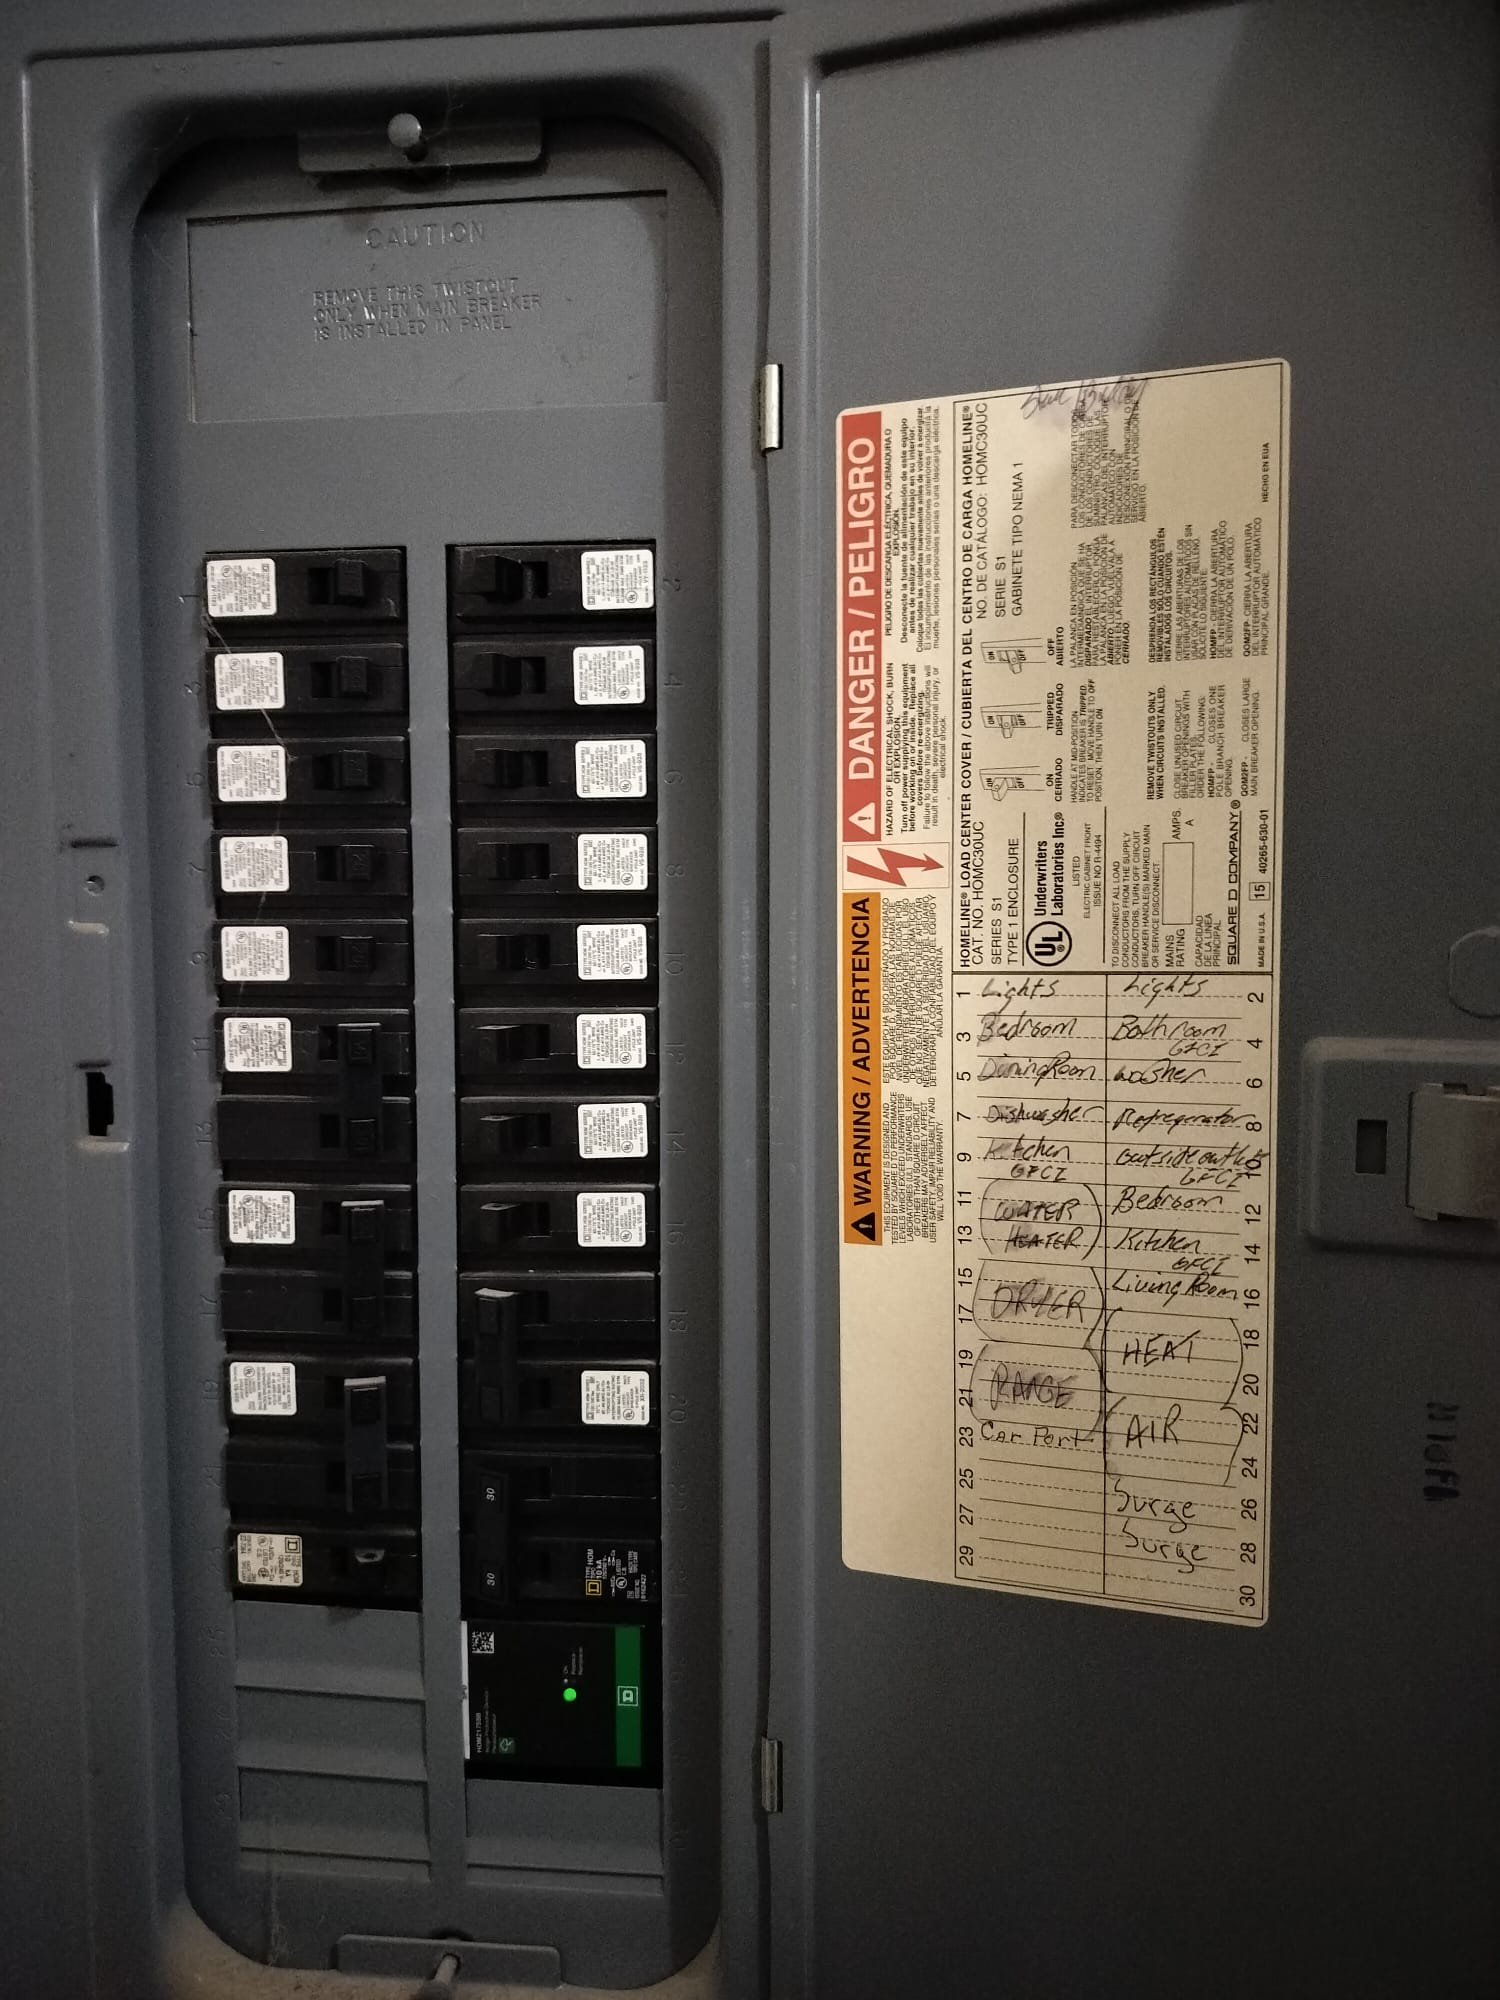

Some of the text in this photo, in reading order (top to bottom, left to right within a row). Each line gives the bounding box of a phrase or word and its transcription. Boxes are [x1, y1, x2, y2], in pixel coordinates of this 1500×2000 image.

[366, 221, 486, 249] CAUTION
[313, 278, 518, 306] REMOVE THIS TWISTOUT
[313, 295, 542, 323] ONLY WHEN MAIN BREAKER
[314, 314, 511, 342] IS INSTALLED IN PANEL
[976, 403, 988, 485] HOMC30UC
[1262, 461, 1269, 472] EN
[1013, 472, 1023, 510] NEMA
[962, 490, 973, 538] CARGA
[1013, 515, 1023, 545] TIPO
[962, 543, 973, 562] DE
[962, 568, 973, 624] CENTRO
[977, 574, 987, 592] DE
[996, 556, 1006, 617] SERIE S1
[1013, 550, 1023, 616] GABINETE
[848, 437, 876, 780] DANGER PELIGRO
[977, 596, 987, 619] NO.
[962, 628, 973, 654] DEL
[1047, 638, 1055, 656] OFF
[1056, 626, 1064, 666] ABIERTO
[886, 690, 894, 724] SHOCK,
[962, 660, 972, 729] CUBIERTA
[1047, 692, 1055, 730] TRIPPED
[1055, 683, 1064, 736] DISPARADO
[1147, 691, 1156, 800] REMOVE TWISTOUTS ONLY
[962, 742, 971, 788] COVER
[886, 785, 893, 797] OF
[1046, 774, 1054, 787] ON
[1055, 758, 1063, 802] CERRADO
[961, 793, 971, 847] CENTER
[1172, 808, 1181, 839] AMPS.
[1186, 818, 1194, 826] A
[1259, 809, 1268, 874] 40265-630-01
[961, 853, 971, 888] LOAD
[1008, 838, 1019, 917] ENCLOSURE
[1034, 841, 1048, 916] Underwriters
[1051, 842, 1064, 916] Laboratories
[1094, 834, 1102, 907] ISSUE NO R-4494
[973, 821, 984, 965] CAT. NO. HOMC30UC
[1228, 889, 1237, 900] D
[1255, 885, 1265, 898] 15
[992, 897, 1001, 964] SERIES S1
[1213, 920, 1221, 967] PRINCIPAL
[1228, 906, 1237, 965] SQUARE
[1009, 931, 1018, 965] TYPE
[1166, 935, 1174, 967] MAINS
[1176, 929, 1186, 967] RATING
[1204, 941, 1212, 952] LA
[1204, 954, 1212, 967] DE
[982, 979, 1059, 1013] Lights
[1124, 975, 1209, 1008] Lights
[1247, 992, 1263, 1003] 2
[957, 1032, 970, 1042] 3
[978, 1011, 1077, 1045] Bedroom
[852, 897, 872, 1206] WARNING ADVERTENCIA
[1246, 1038, 1262, 1049] 4
[957, 1071, 971, 1081] 5
[1246, 1078, 1261, 1089] 6
[957, 1112, 971, 1122] 7
[1245, 1121, 1261, 1132] 8
[957, 1152, 971, 1162] 9
[1245, 1159, 1261, 1179] 10
[958, 1190, 972, 1206] 11
[1245, 1204, 1261, 1224] 12
[958, 1225, 972, 1244] 13
[1244, 1244, 1260, 1265] 14
[958, 1267, 973, 1287] 15
[1244, 1288, 1260, 1309] 16
[959, 1304, 973, 1323] 17
[1123, 1330, 1201, 1367] HEAT
[1243, 1329, 1260, 1350] 18
[959, 1350, 973, 1368] 19
[959, 1388, 973, 1407] 21
[1243, 1373, 1259, 1395] 20
[959, 1426, 973, 1447] 23
[981, 1421, 1094, 1449] Car Port
[1126, 1404, 1181, 1448] AIR
[1243, 1412, 1258, 1435] 22
[959, 1468, 973, 1489] 25
[1242, 1456, 1257, 1478] 24
[485, 1487, 497, 1502] 30
[1115, 1479, 1196, 1533] Surge
[959, 1503, 973, 1526] 27
[1241, 1498, 1257, 1521] 26
[959, 1545, 973, 1566] 29
[1123, 1518, 1208, 1573] Surge
[1240, 1542, 1256, 1564] 28
[486, 1572, 497, 1587] 30
[1240, 1585, 1256, 1607] 30
